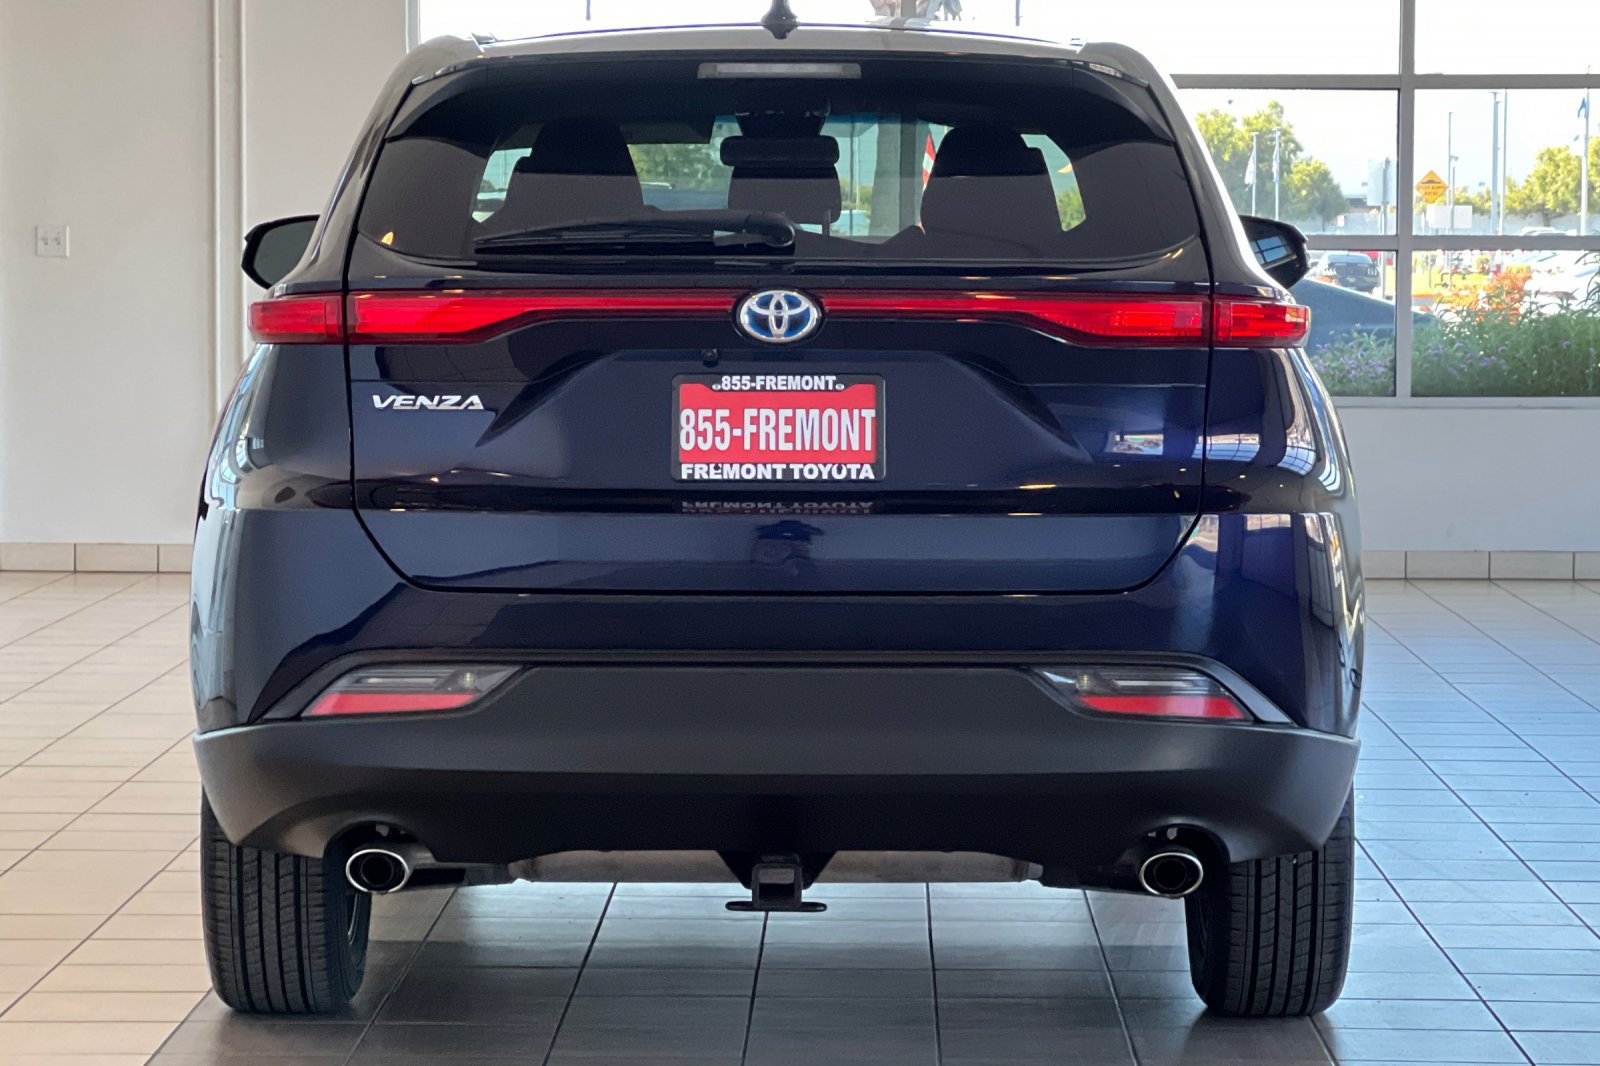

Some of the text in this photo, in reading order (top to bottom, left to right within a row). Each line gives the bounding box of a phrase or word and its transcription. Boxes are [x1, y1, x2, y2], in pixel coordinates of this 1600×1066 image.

[721, 375, 837, 391] 855-FREMONT
[372, 394, 485, 410] VENZA
[680, 408, 876, 451] 855-FREMONT
[681, 463, 875, 480] FREMONT TOYOTA
